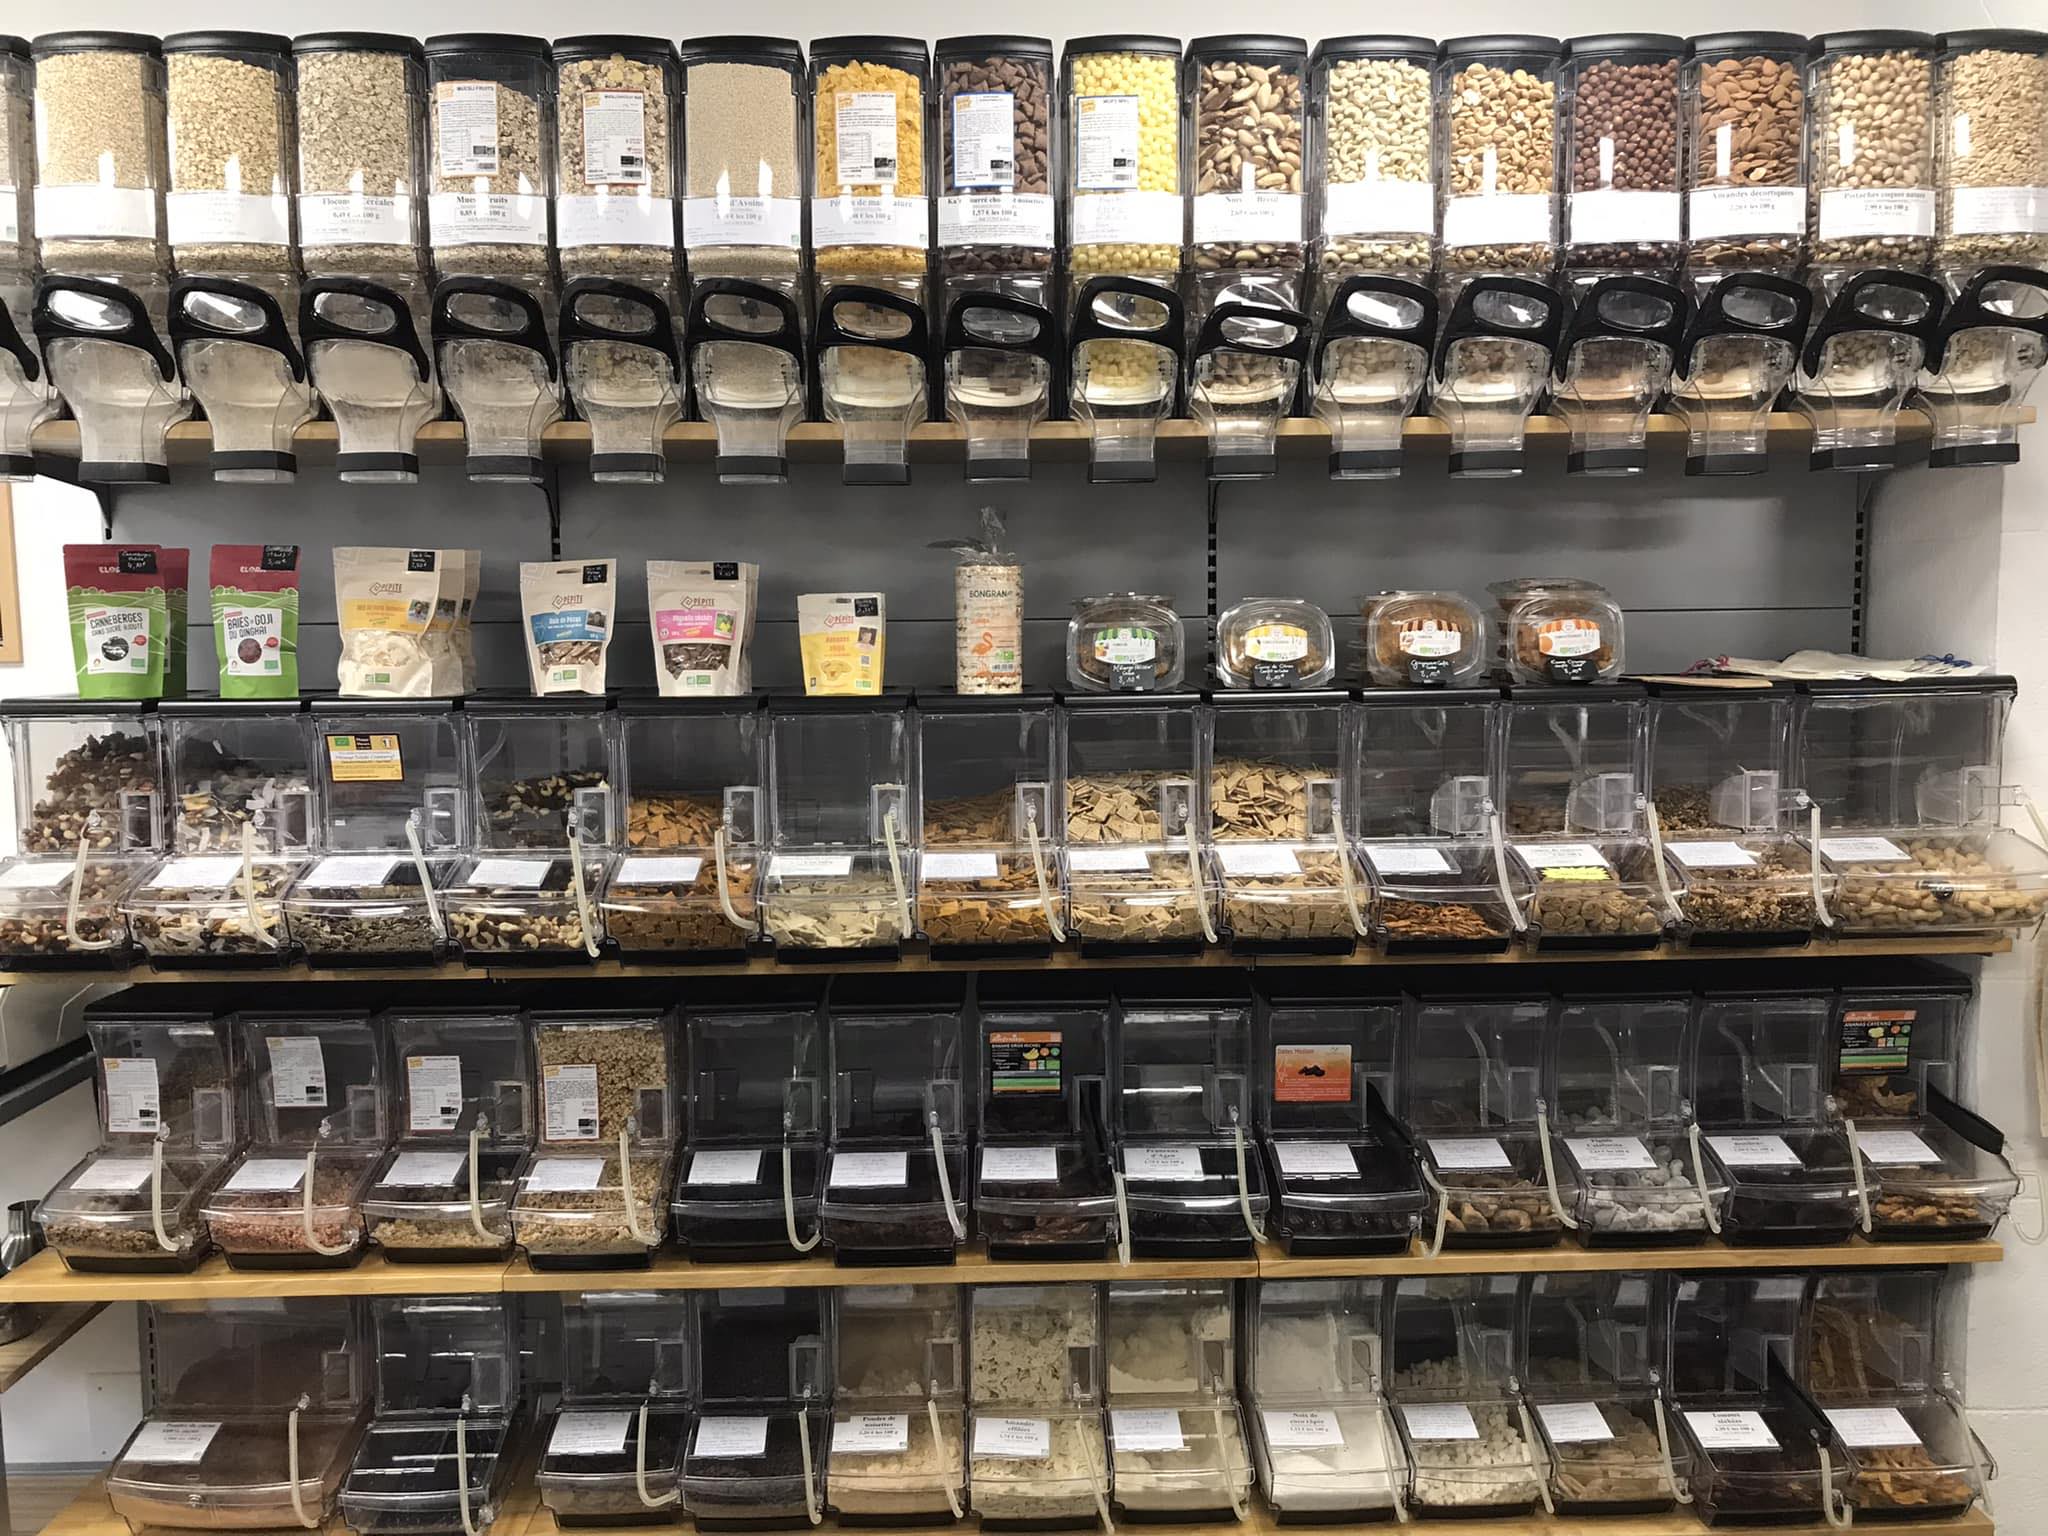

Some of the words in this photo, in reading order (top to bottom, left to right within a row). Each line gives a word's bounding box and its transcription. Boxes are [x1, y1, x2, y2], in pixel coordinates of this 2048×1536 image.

[364, 197, 395, 207] éréales
[90, 612, 144, 629] CANNEBERGES
[226, 615, 250, 630] BAIES
[254, 613, 274, 626] GOJI
[229, 630, 238, 640] DU
[238, 626, 268, 638] QINGHAI
